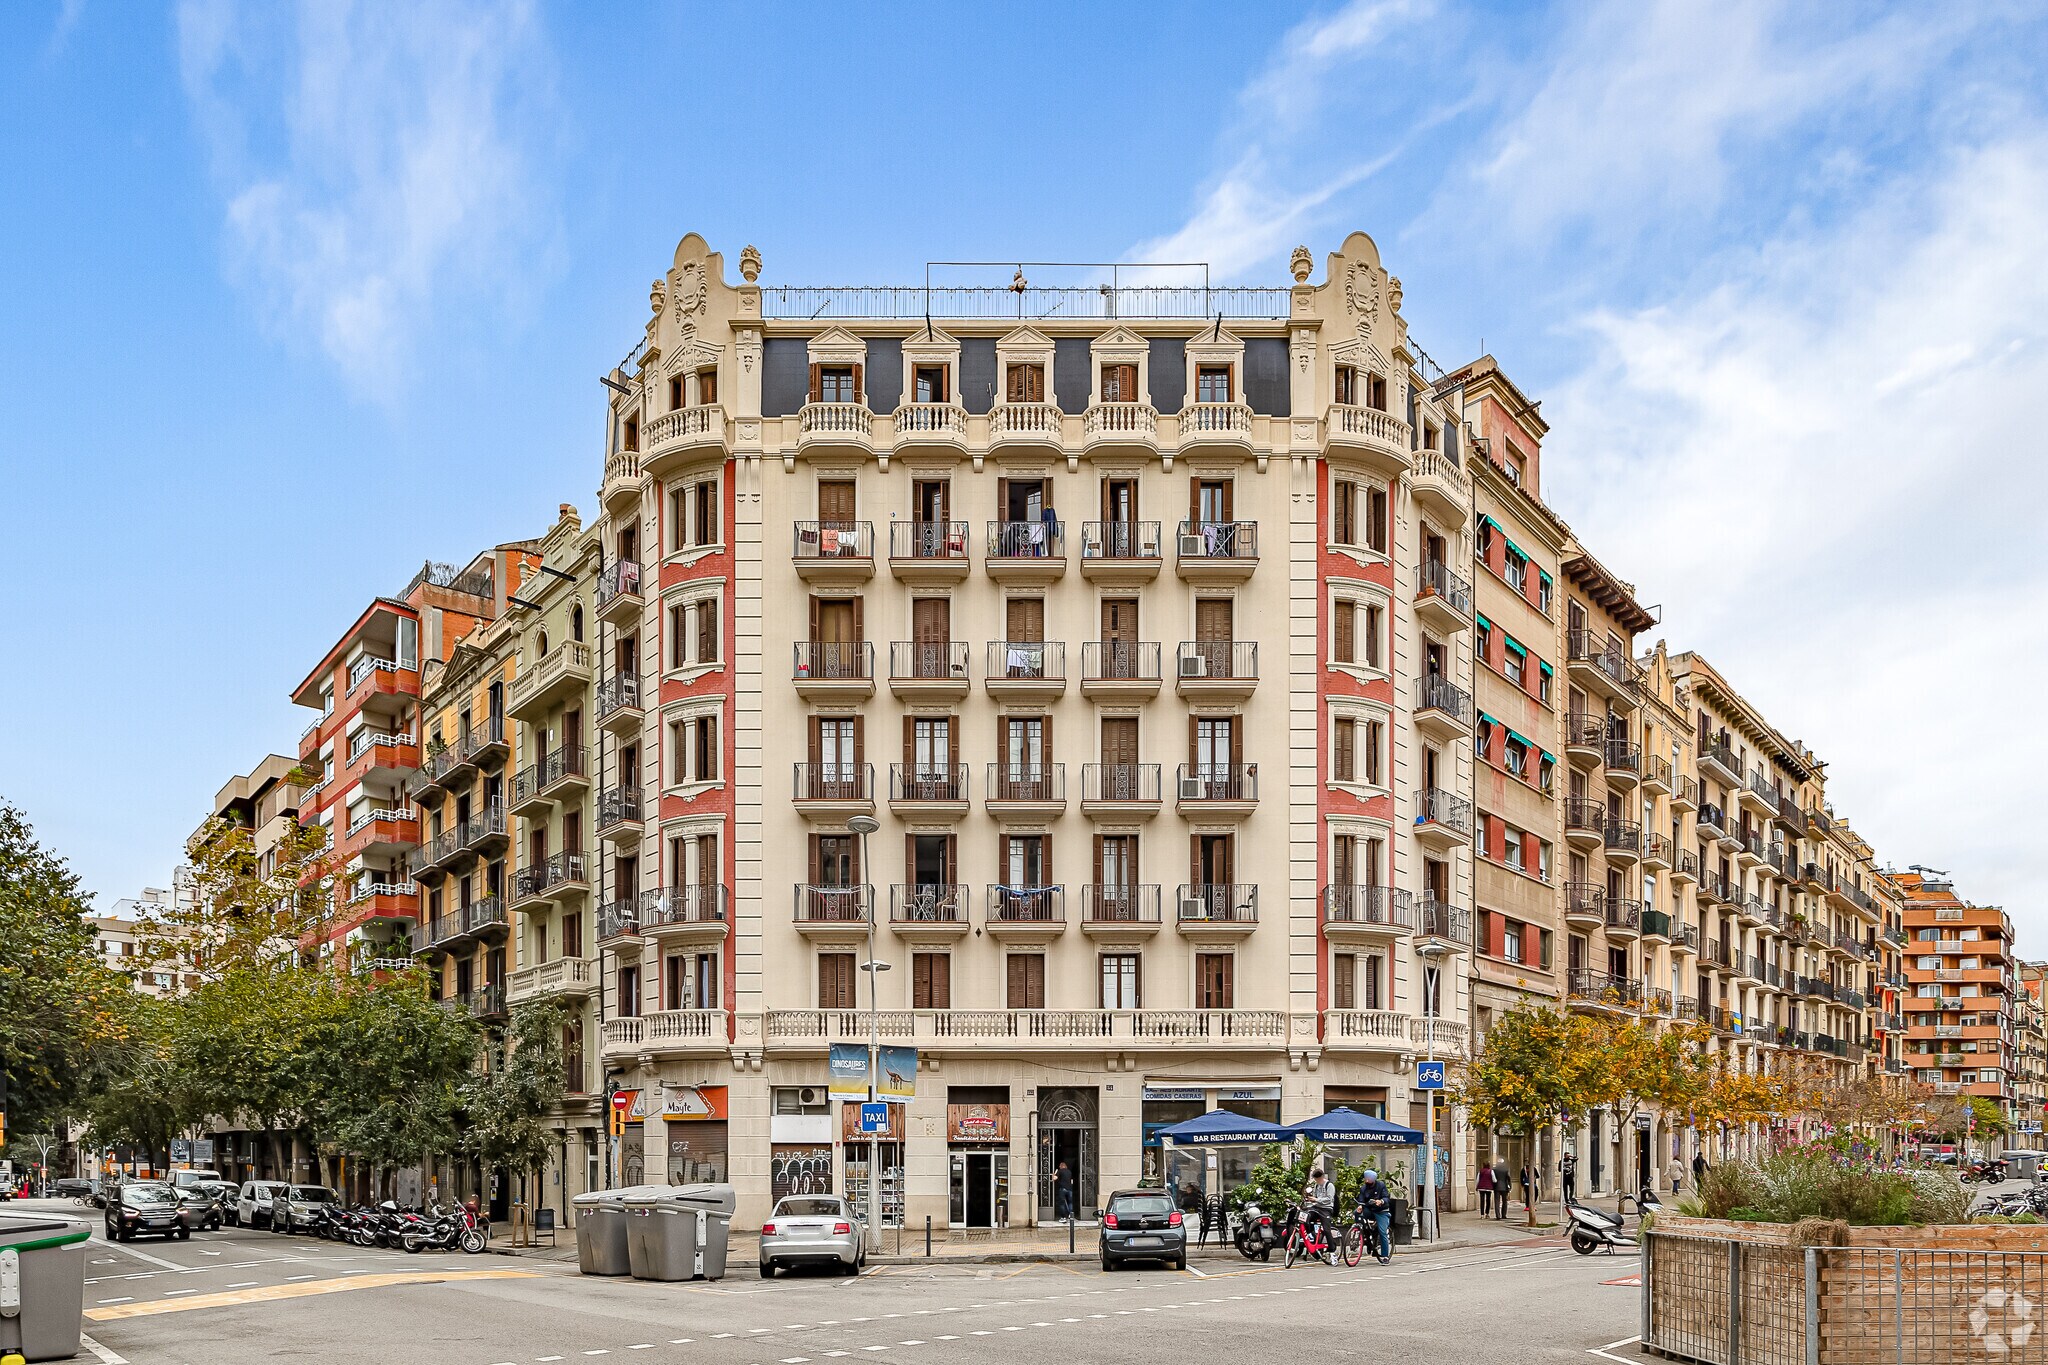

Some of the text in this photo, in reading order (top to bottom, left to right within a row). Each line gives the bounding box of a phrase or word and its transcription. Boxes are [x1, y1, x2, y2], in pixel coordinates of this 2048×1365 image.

[832, 1059, 866, 1069] DINOSAURES
[1232, 1091, 1255, 1099] AZUL
[667, 1102, 692, 1114] Mayte
[864, 1112, 885, 1122] TAXI
[1210, 1133, 1257, 1142] RESTAURANT
[1323, 1132, 1406, 1142] BAR RESTAURANT AZUL
